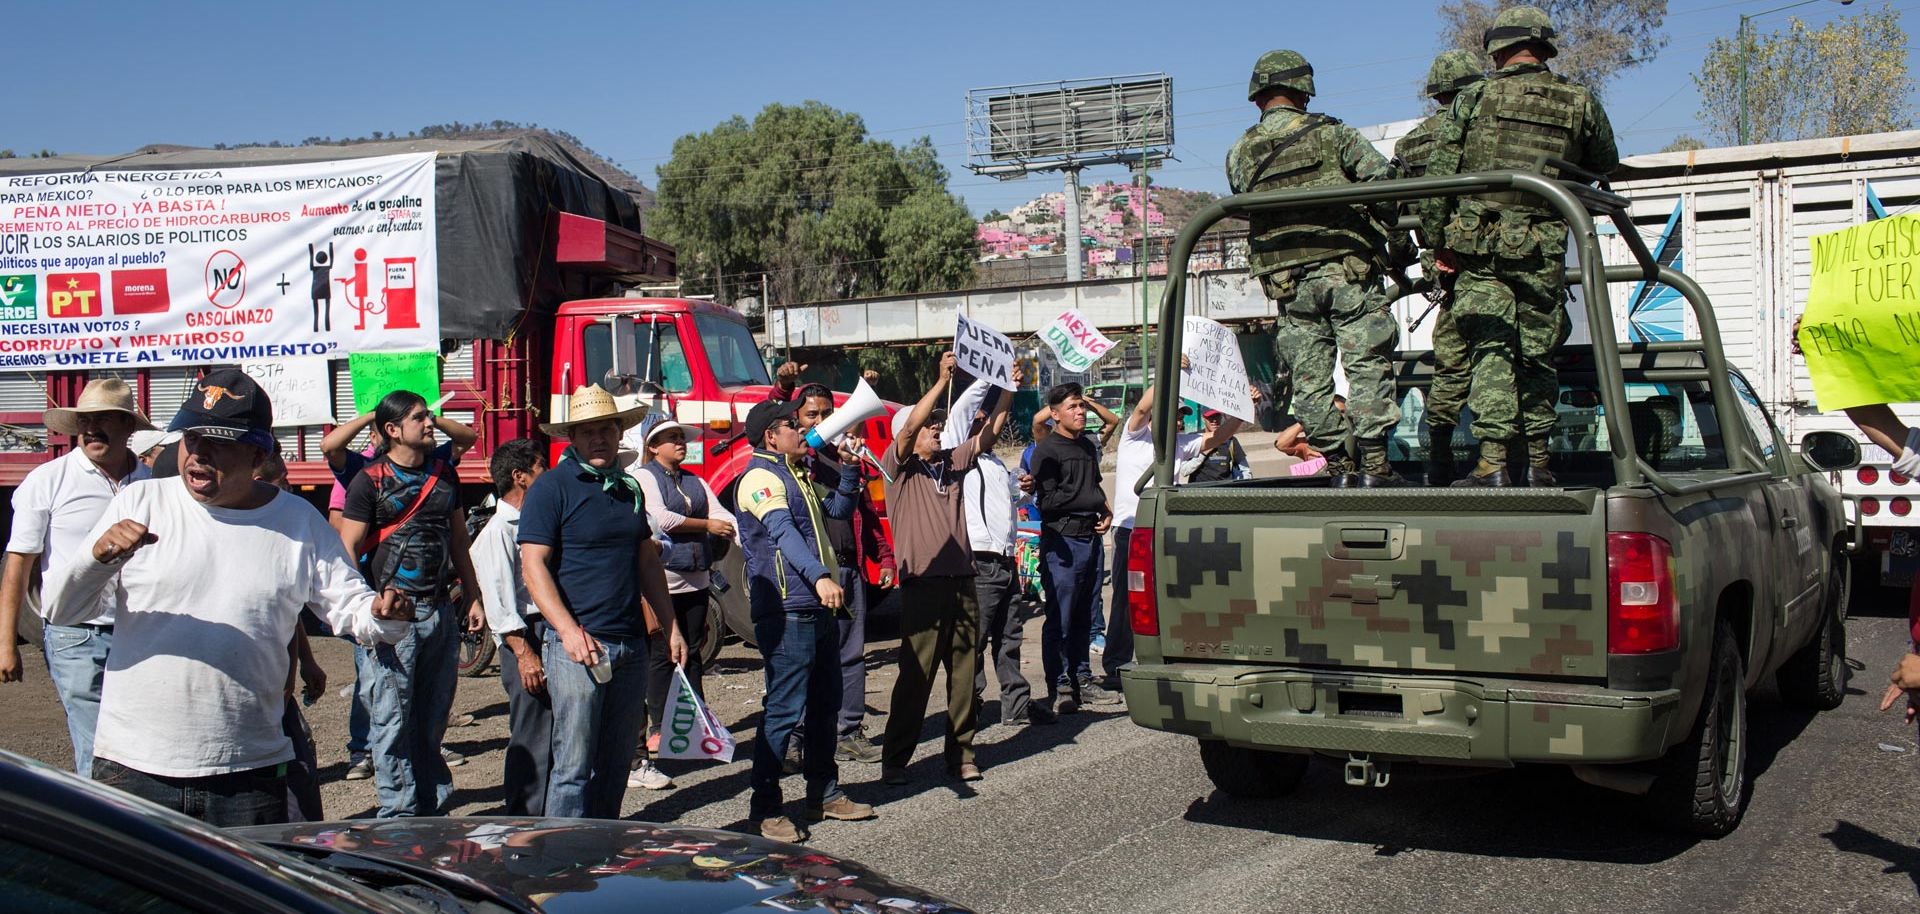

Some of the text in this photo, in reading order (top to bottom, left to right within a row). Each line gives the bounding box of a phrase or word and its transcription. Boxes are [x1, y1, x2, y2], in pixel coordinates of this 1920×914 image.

[9, 171, 222, 187] REFORMA ENERGETICA
[188, 184, 224, 196] PEOR
[227, 182, 262, 194] PARA
[265, 181, 292, 192] LOS
[296, 175, 383, 190] MEXICANOS?
[1, 190, 93, 204] PARA MEXICO?
[301, 194, 422, 217] Aumento de la gasolina
[14, 203, 61, 219] PEÑA
[66, 203, 117, 217] NIETO
[132, 202, 153, 214] YA
[158, 199, 216, 213] BASTA
[387, 210, 411, 219] ESTAFA
[66, 220, 84, 231] AL
[87, 218, 139, 230] PRECIO
[143, 217, 160, 228] DE
[166, 211, 291, 227] HIDROCARBUROS
[333, 226, 365, 236] vamos
[376, 219, 423, 236] enfrentar
[34, 236, 63, 249] LOS
[67, 233, 140, 248] SALARIOS
[145, 232, 164, 245] DE
[169, 229, 248, 244] POLITICOS
[41, 258, 61, 270] que
[64, 256, 105, 270] apoyan
[109, 254, 118, 265] al
[121, 251, 166, 269] pueblo?
[1813, 232, 1839, 276] NO
[1842, 226, 1860, 265] AL
[124, 284, 155, 292] morena
[214, 267, 241, 290] NO
[1851, 261, 1916, 304] FUER
[52, 290, 96, 315] PT
[1, 323, 80, 335] NECESITAN
[84, 321, 129, 333] VOTOS
[186, 309, 273, 327] GASOLINAZO
[0, 331, 244, 352] CORRUPTO Y MENTIROSO
[958, 320, 1015, 358] FUERA
[1803, 313, 1873, 356] PEÑA
[55, 351, 129, 365] UNETE
[136, 350, 165, 362] AL
[959, 342, 1008, 384] PEÑA
[247, 363, 284, 378] ESTA
[1186, 375, 1217, 399] LUCHA
[205, 428, 234, 437] TEXAS
